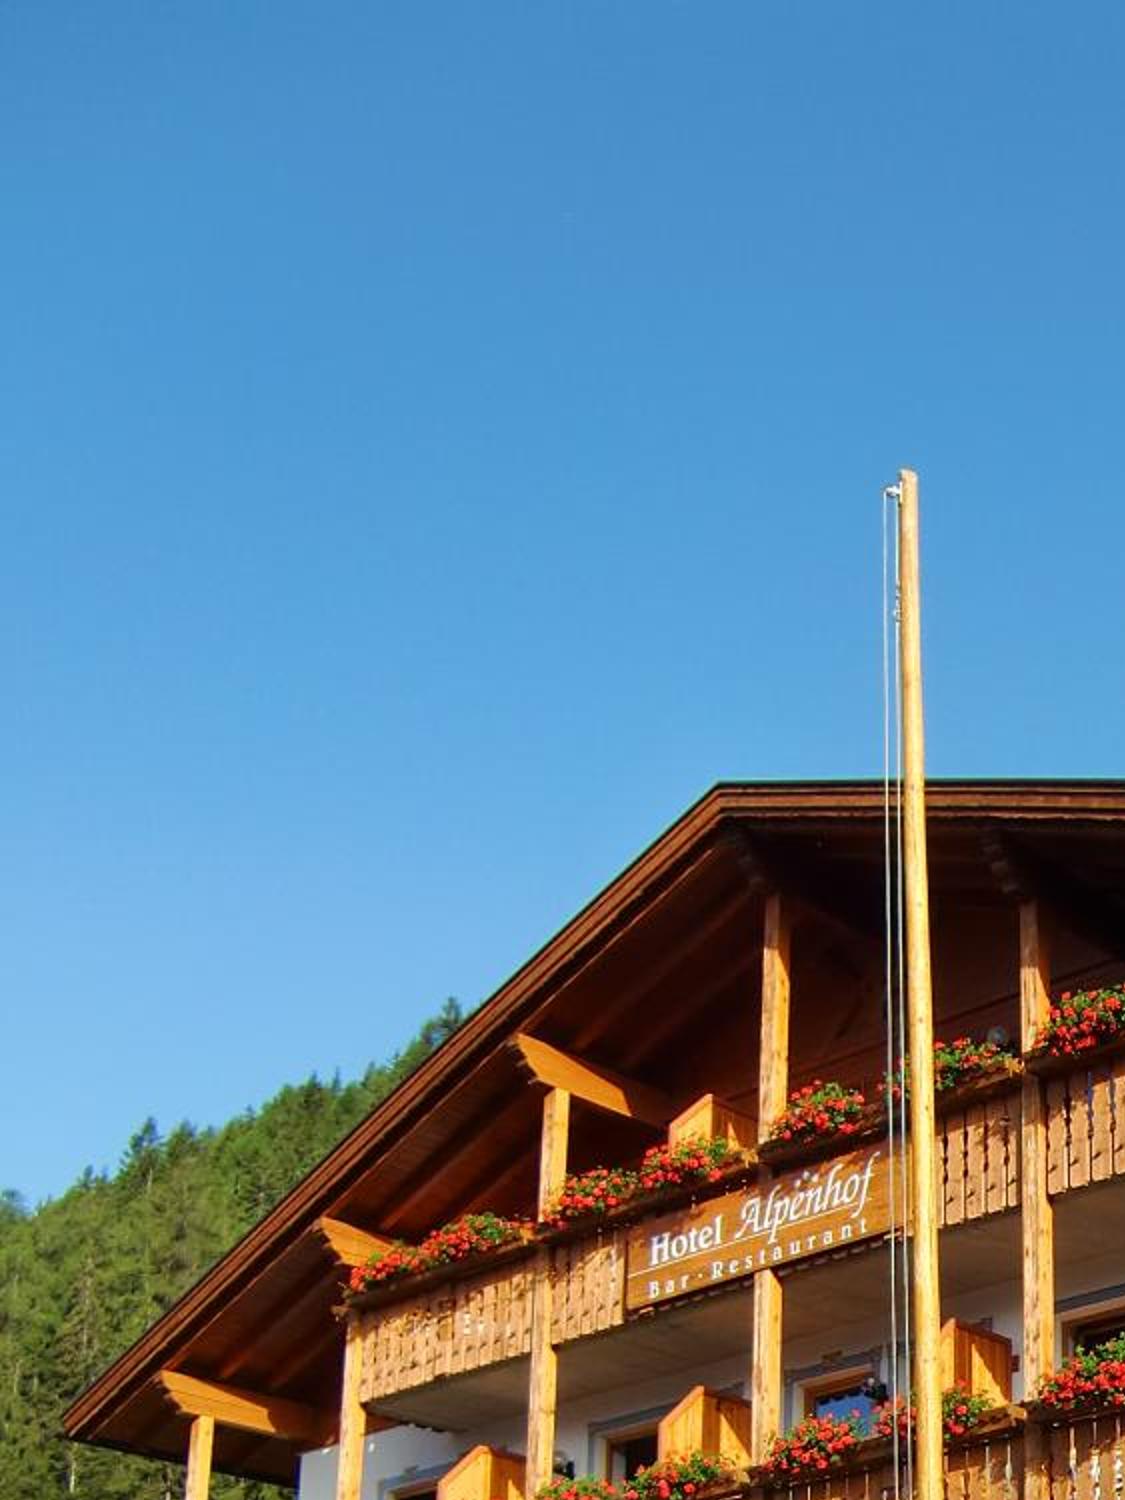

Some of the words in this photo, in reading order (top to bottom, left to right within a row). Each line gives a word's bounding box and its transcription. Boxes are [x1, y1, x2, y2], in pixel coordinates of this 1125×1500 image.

[650, 1215, 722, 1265] Hotel
[734, 1151, 880, 1245] Alpenhof
[649, 1274, 690, 1299] Bar
[711, 1218, 869, 1280] Restaurant
